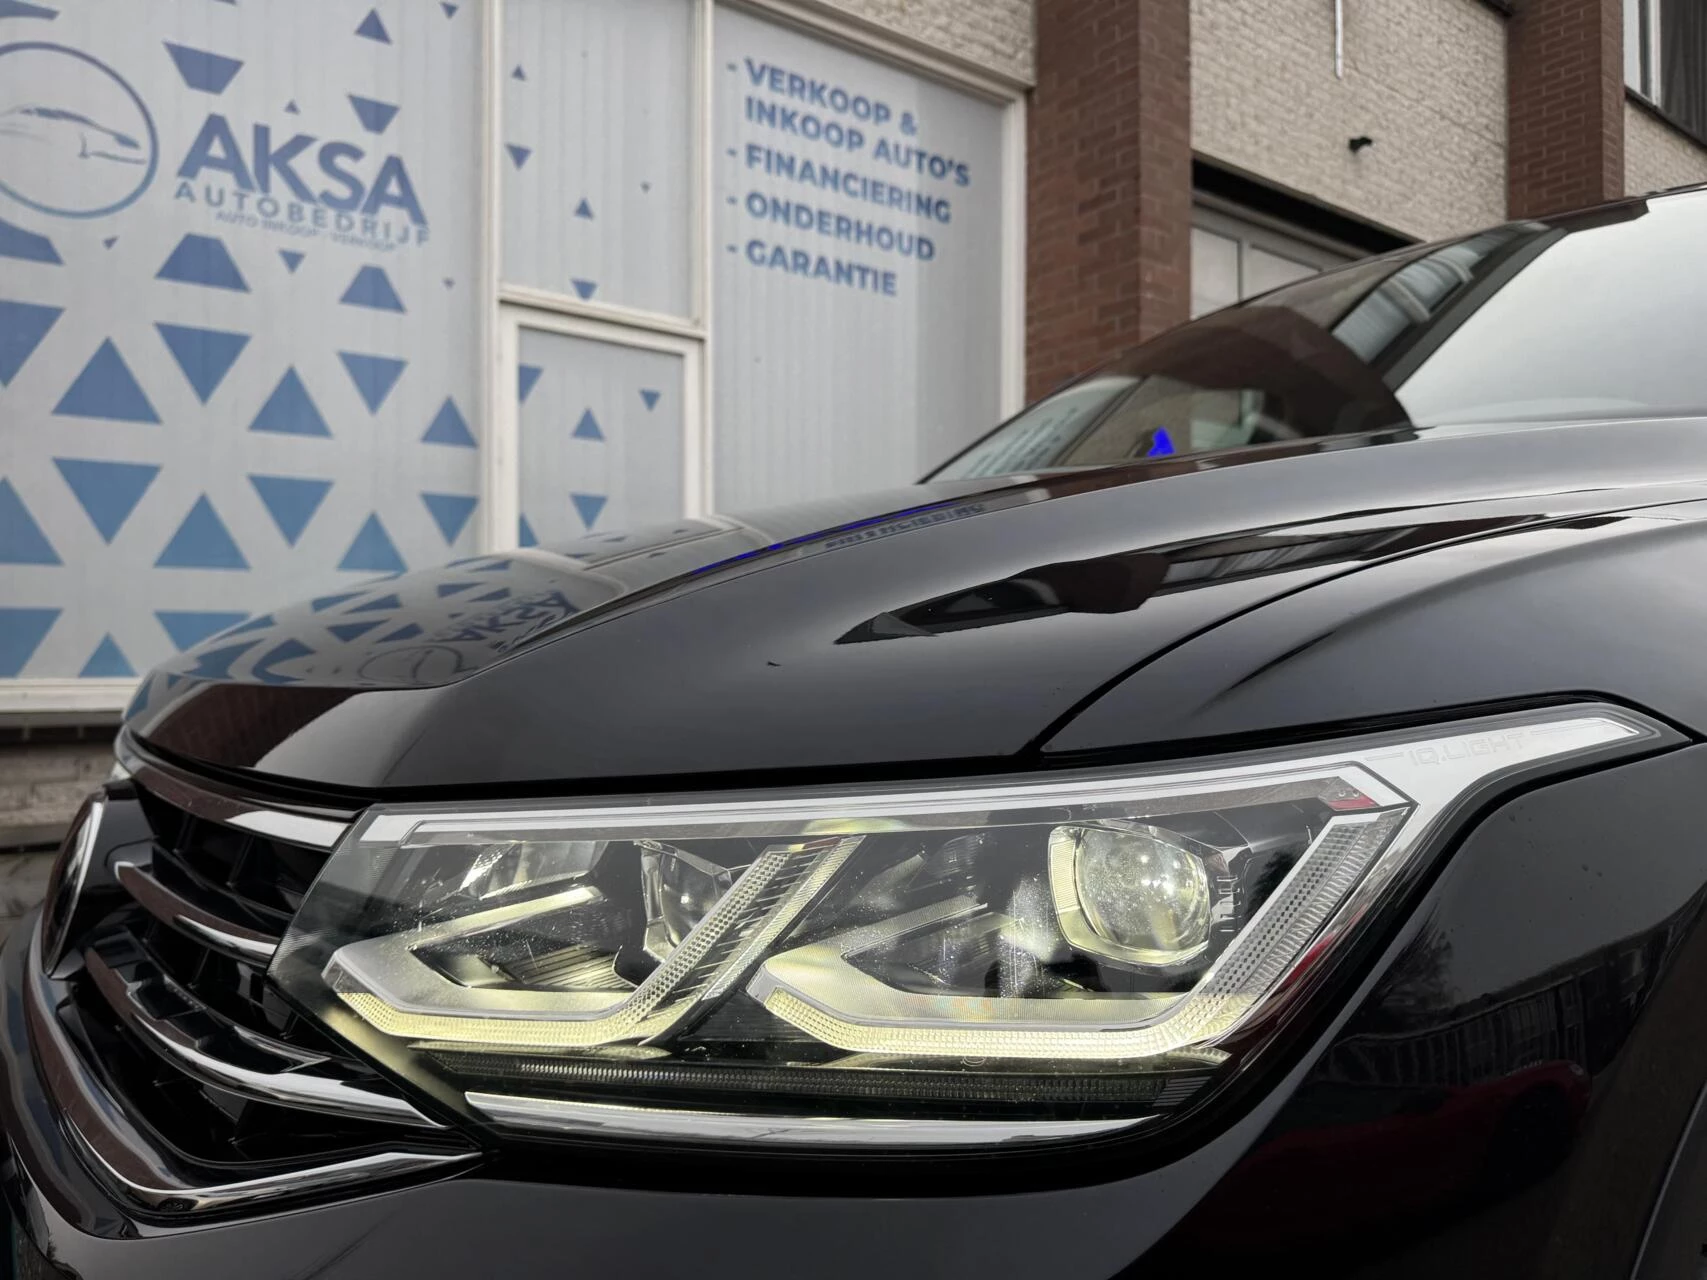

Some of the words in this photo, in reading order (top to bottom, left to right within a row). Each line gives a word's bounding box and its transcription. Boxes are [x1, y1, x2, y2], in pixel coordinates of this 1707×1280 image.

[744, 57, 891, 126] VERKOOP
[900, 111, 918, 136] &
[176, 112, 430, 226] AKSA
[745, 95, 864, 151] INKOOP
[873, 137, 971, 187] AUTO'S
[174, 180, 430, 247] AUTOBEDRIJF
[215, 209, 259, 229] AUTO
[745, 143, 952, 224] FINANCIERING
[745, 191, 936, 262] ONDERHOUD
[745, 239, 897, 297] GARANTIE
[1409, 732, 1524, 766] IQ.LIGHT
